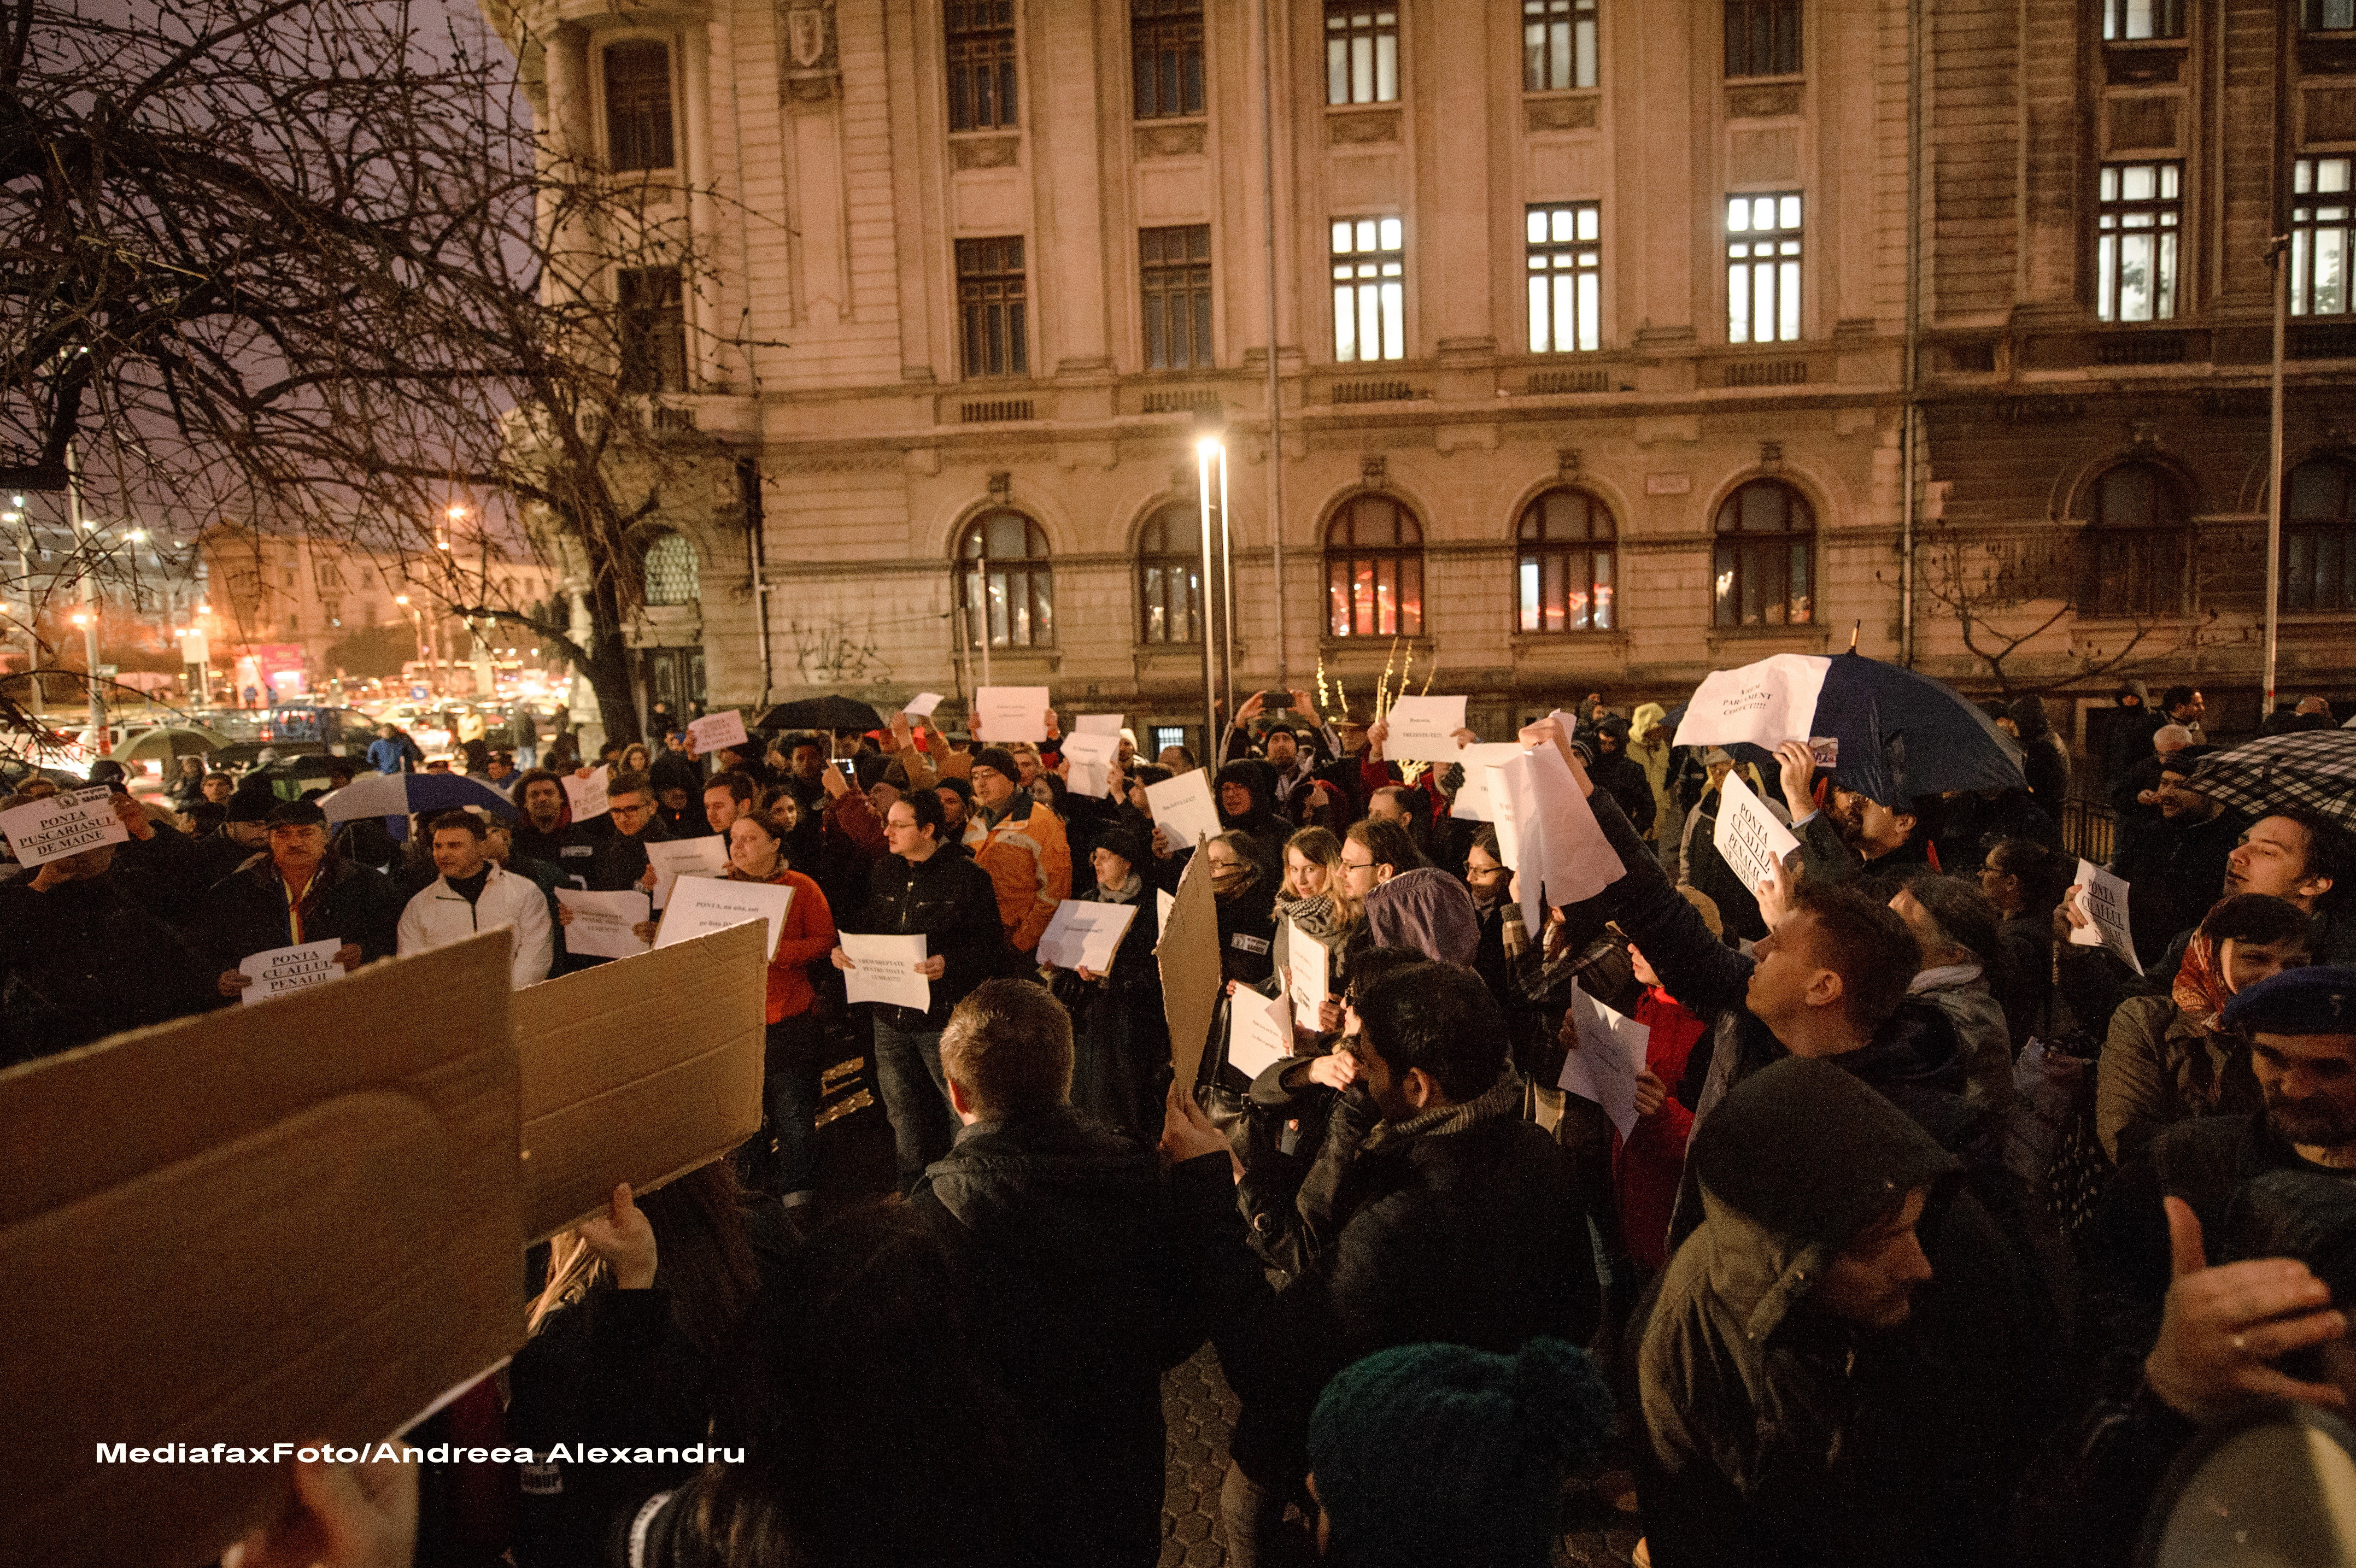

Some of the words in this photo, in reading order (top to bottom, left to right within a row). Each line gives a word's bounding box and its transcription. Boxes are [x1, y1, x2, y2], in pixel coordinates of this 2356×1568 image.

[39, 811, 86, 829] PONTA
[1732, 814, 1743, 833] CU
[1740, 803, 1768, 844] PONTA
[19, 817, 115, 847] PUSCARIASUL
[37, 844, 56, 856] DE
[58, 830, 104, 847] MAINE
[2088, 879, 2114, 903] PONTA
[272, 951, 319, 965] PONTA
[262, 968, 283, 978] CU
[271, 973, 326, 990] PENALII
